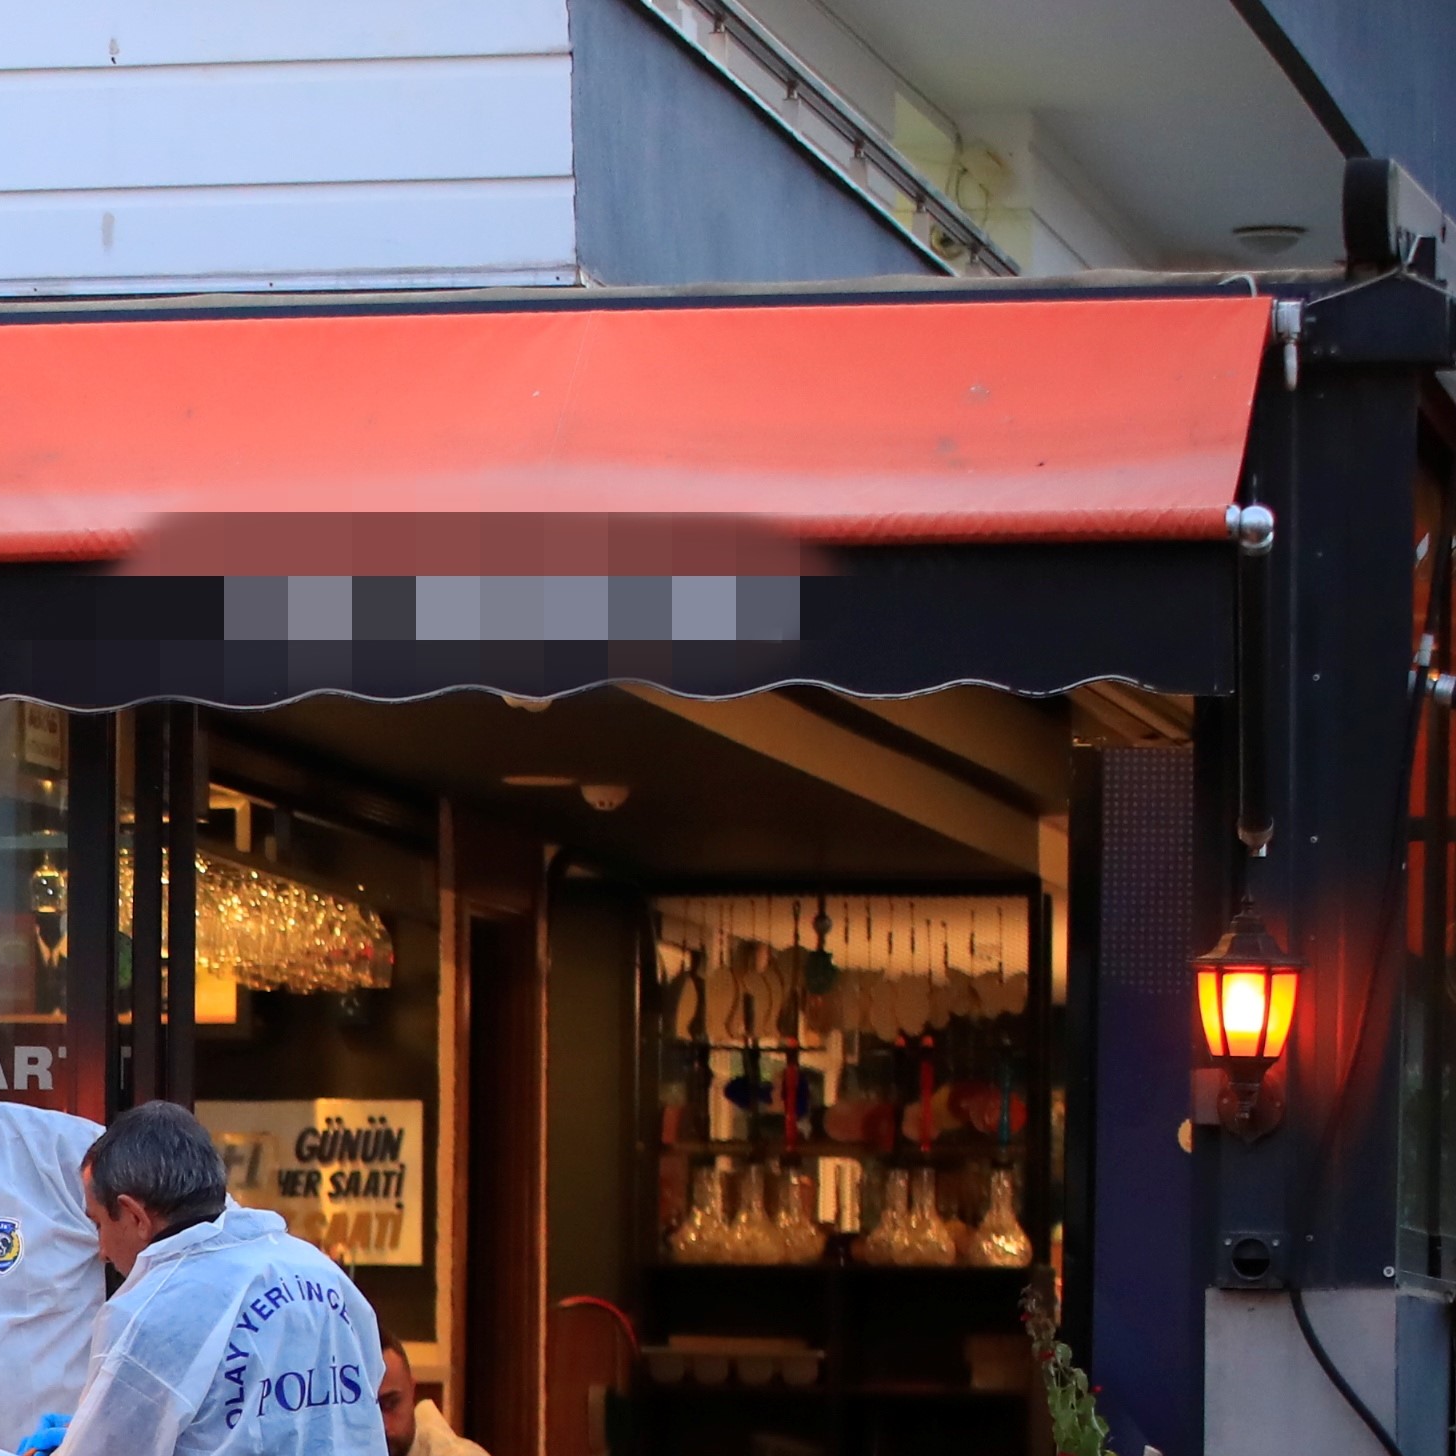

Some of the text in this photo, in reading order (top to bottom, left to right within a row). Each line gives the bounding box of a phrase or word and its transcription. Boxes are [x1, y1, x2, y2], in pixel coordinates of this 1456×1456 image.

[295, 1116, 404, 1164] GÜNÜN
[328, 1164, 406, 1199] SAATİ
[236, 1277, 294, 1334] YERİ
[256, 1356, 362, 1418] POLİS
